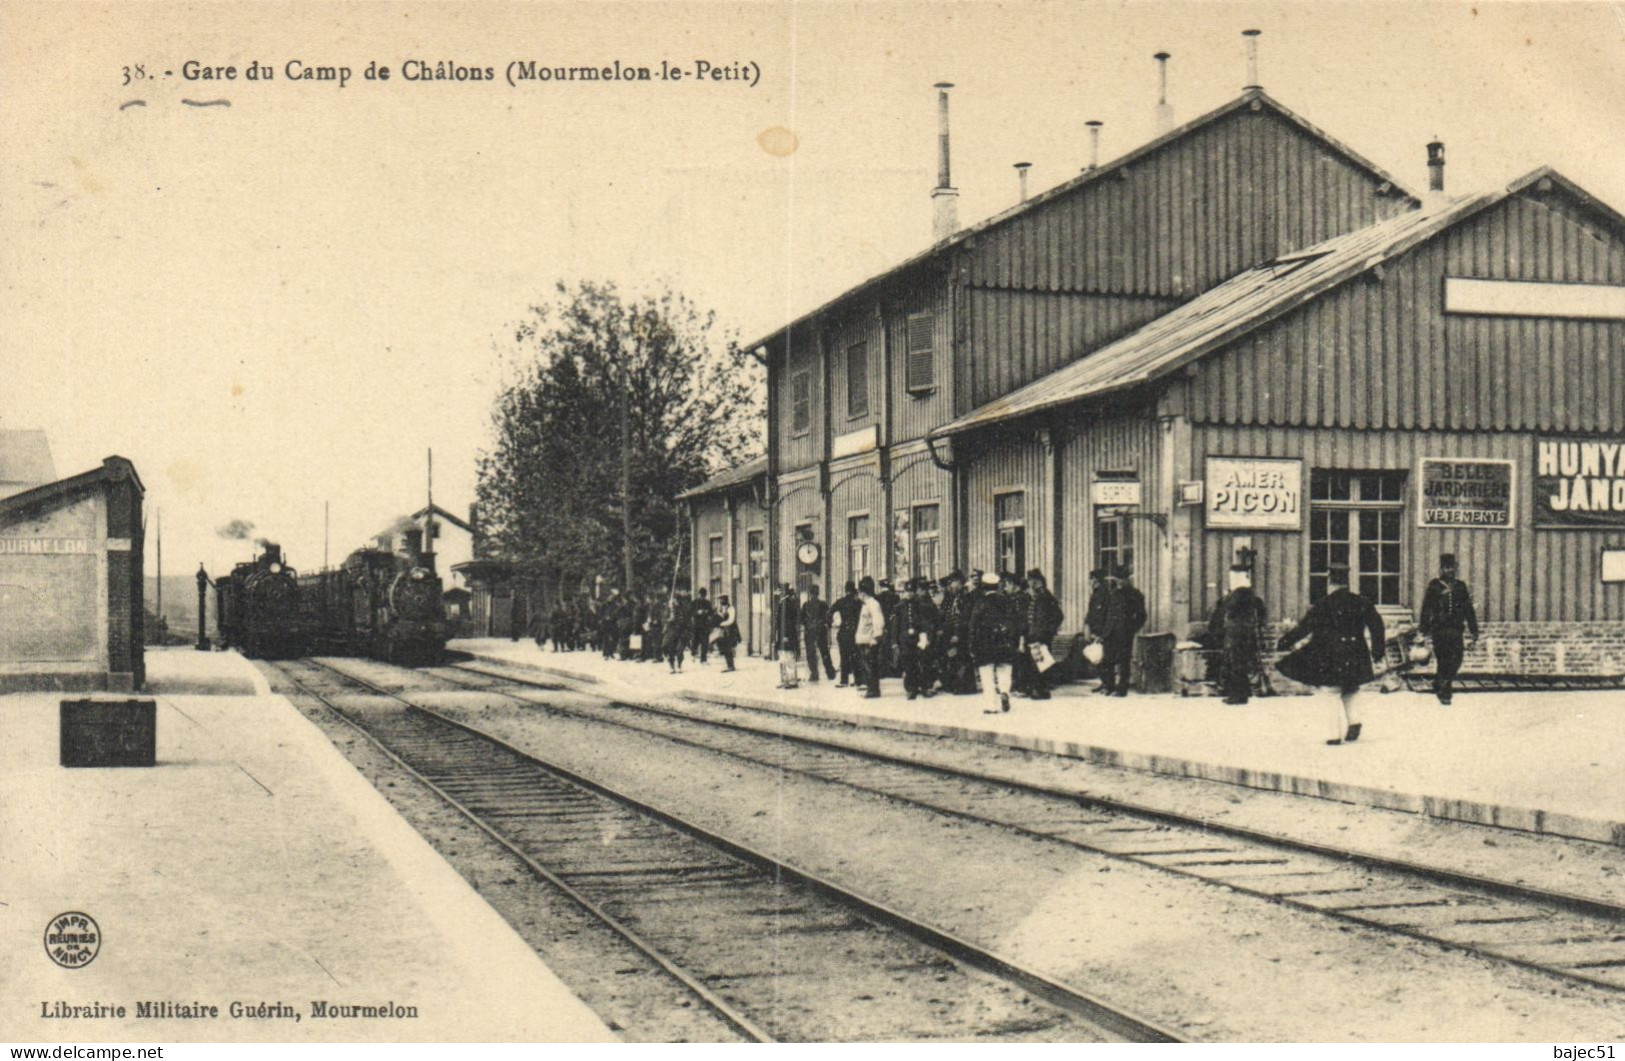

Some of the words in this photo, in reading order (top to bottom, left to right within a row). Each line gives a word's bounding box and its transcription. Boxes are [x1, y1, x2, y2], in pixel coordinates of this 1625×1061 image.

[1224, 470, 1285, 489] AMER
[1442, 463, 1495, 479] BELLE
[1211, 488, 1297, 513] PICON
